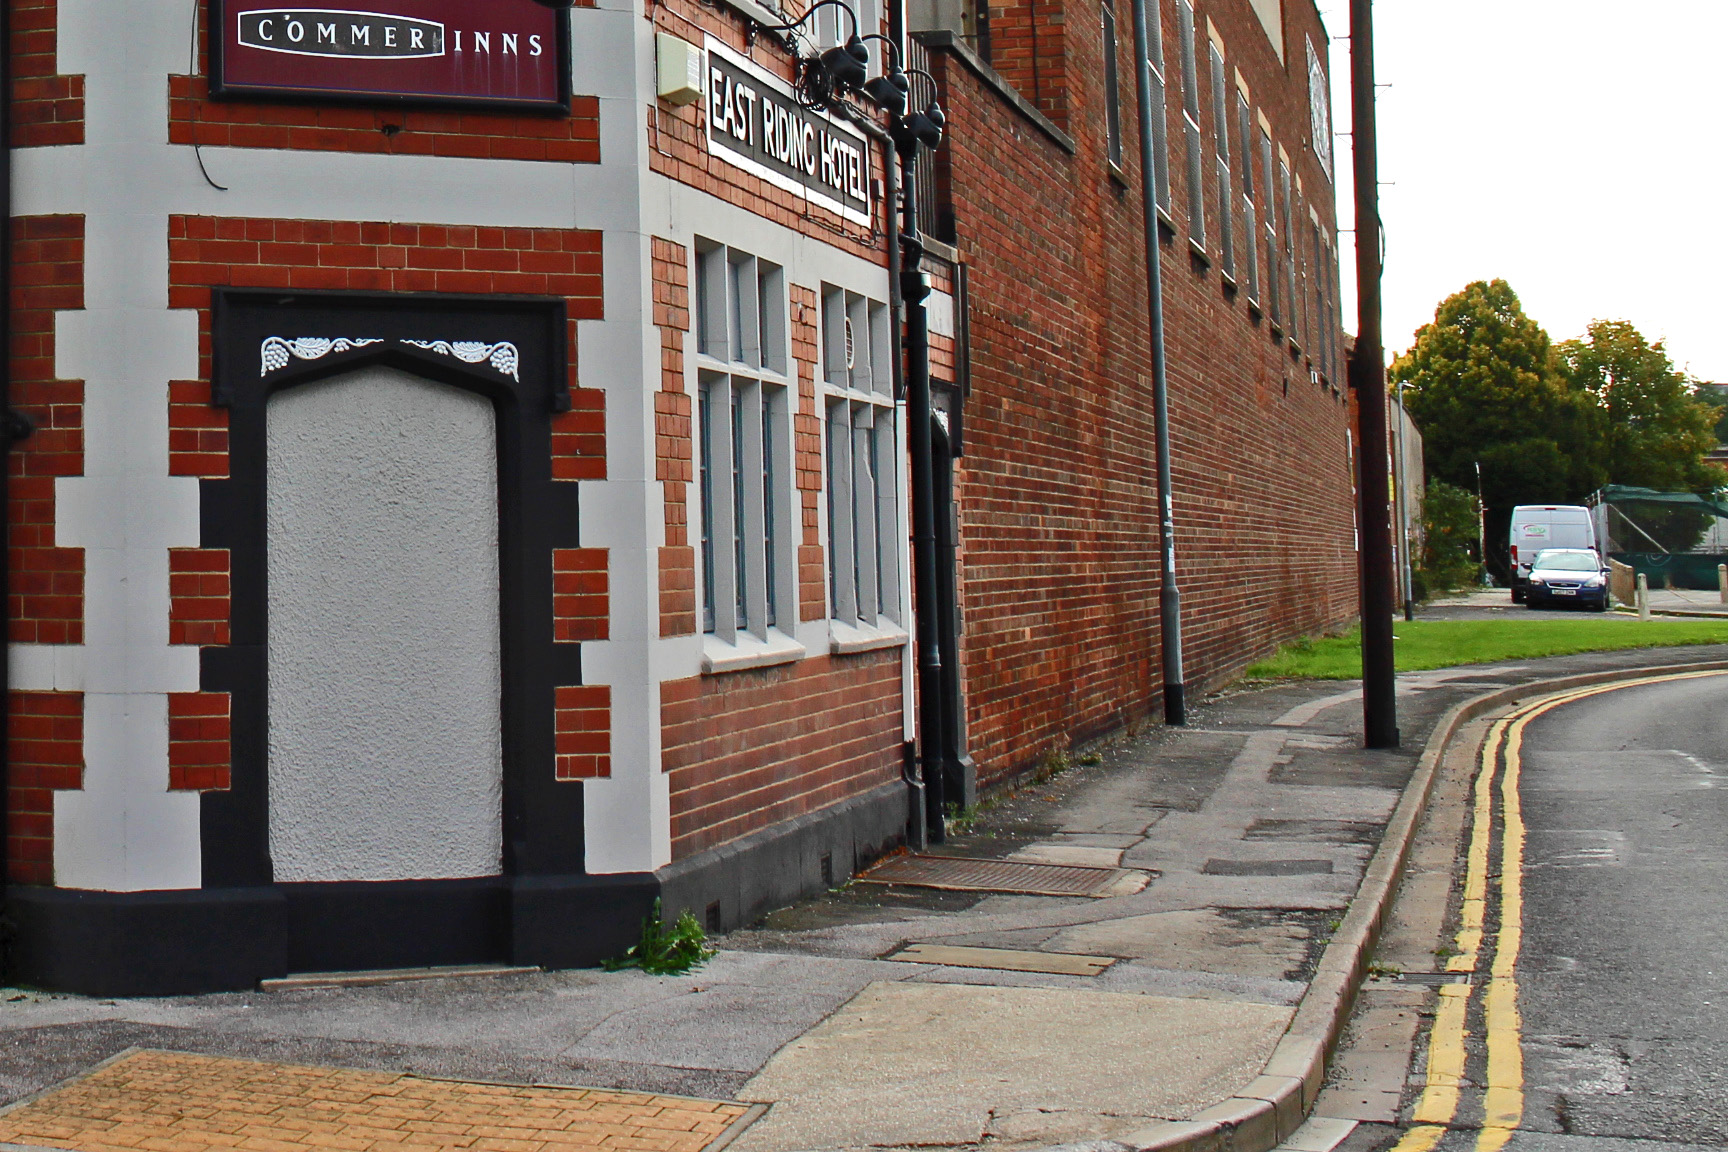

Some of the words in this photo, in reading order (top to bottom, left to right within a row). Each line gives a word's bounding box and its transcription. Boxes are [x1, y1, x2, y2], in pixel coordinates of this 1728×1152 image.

[258, 20, 424, 49] COMMER
[453, 30, 542, 56] INNS
[710, 66, 756, 146] EAST
[762, 97, 816, 176] RIDING
[820, 129, 866, 203] HOTEL
